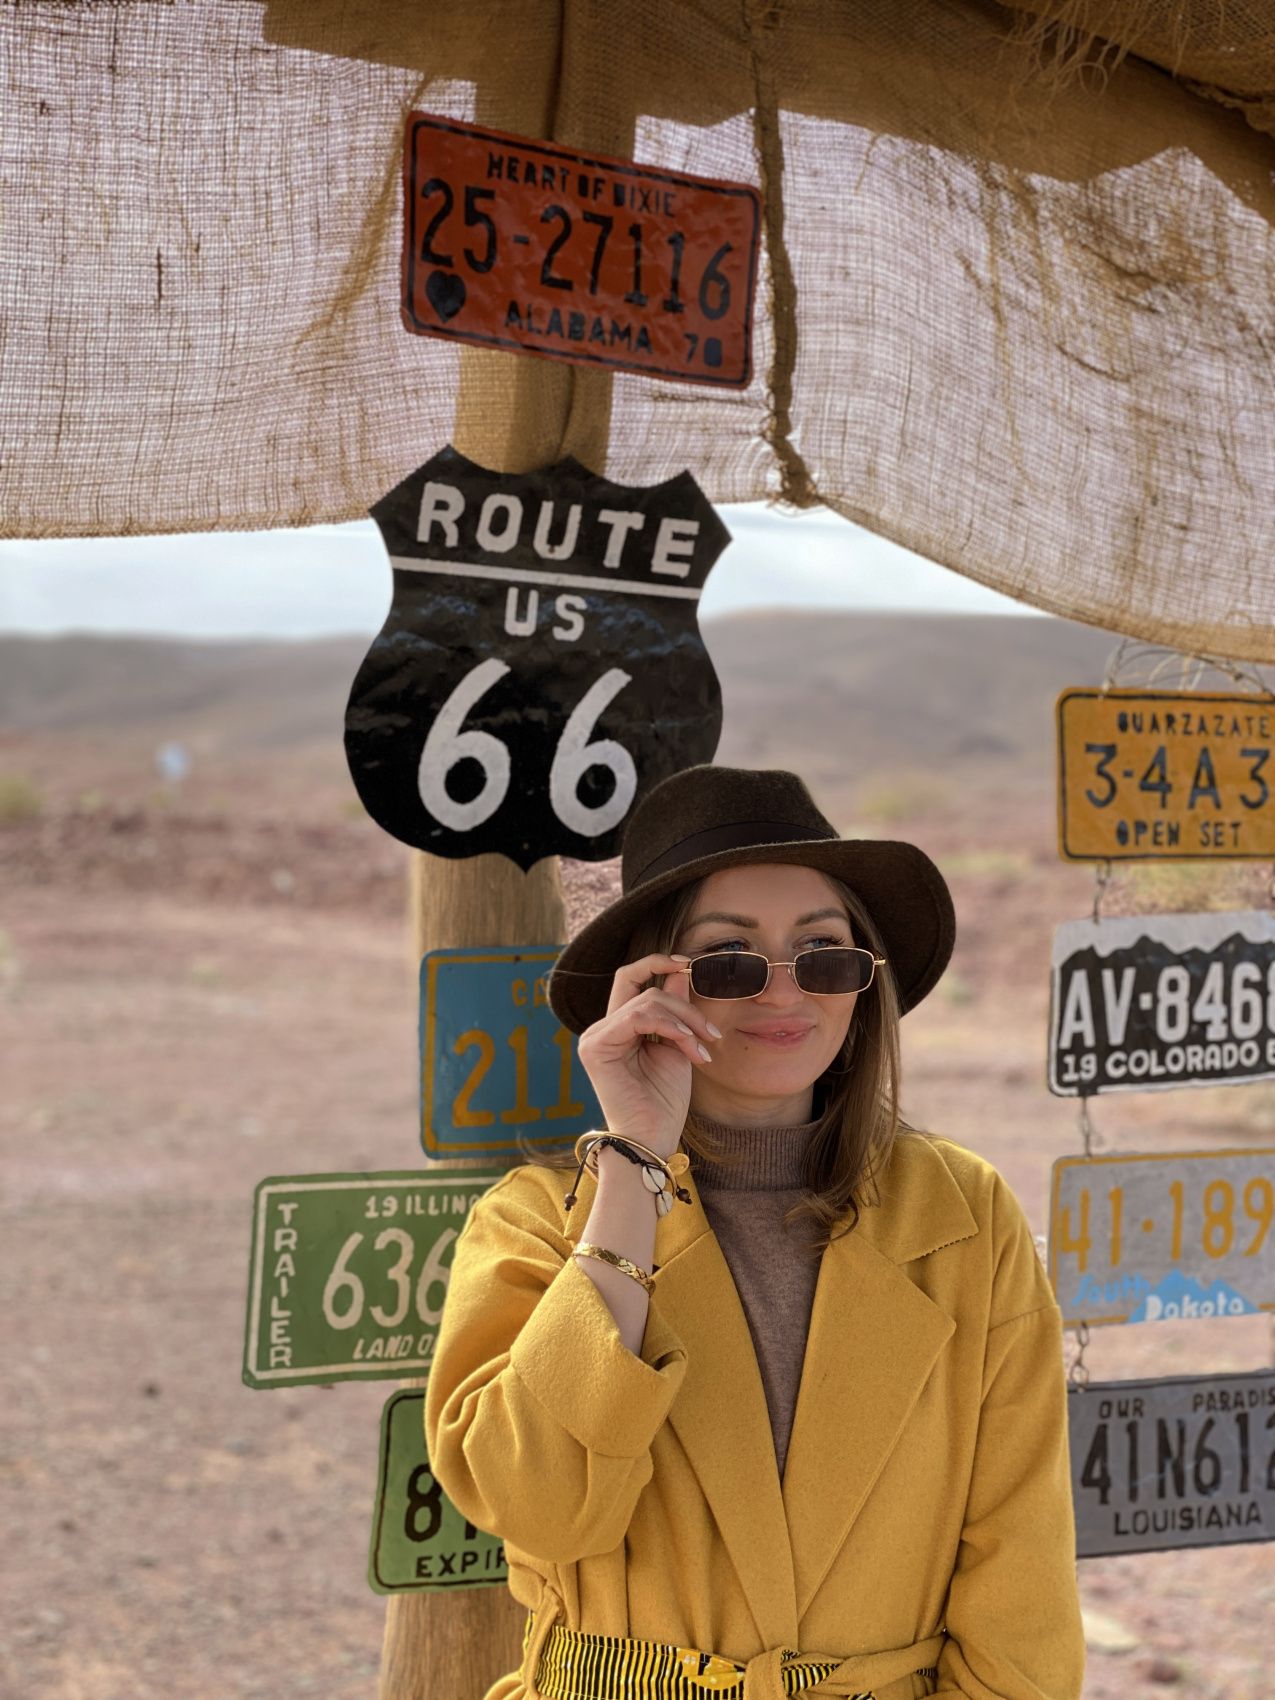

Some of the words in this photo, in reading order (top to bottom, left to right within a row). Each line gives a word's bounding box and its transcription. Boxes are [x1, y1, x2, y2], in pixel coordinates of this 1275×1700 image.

[486, 152, 571, 193] HEART
[578, 175, 606, 199] OF
[614, 182, 676, 218] DIXIE
[421, 178, 734, 320] 25-27116
[505, 300, 654, 354] ALABAMA
[416, 481, 699, 578] ROUTE
[504, 587, 588, 642] US
[417, 657, 638, 838] 66
[1116, 820, 1180, 847] OPEN
[1201, 821, 1243, 848] SET
[1062, 1054, 1098, 1082] 19
[1105, 1041, 1260, 1079] COLORADO
[364, 1195, 399, 1219] 19
[269, 1202, 299, 1368] TRAILER
[322, 1227, 459, 1330] 636
[1145, 1290, 1245, 1321] Dakota
[352, 1334, 415, 1360] LAND
[417, 1333, 437, 1357] O
[1098, 1398, 1145, 1420] OUR
[1114, 1502, 1262, 1537] LOUISIANA
